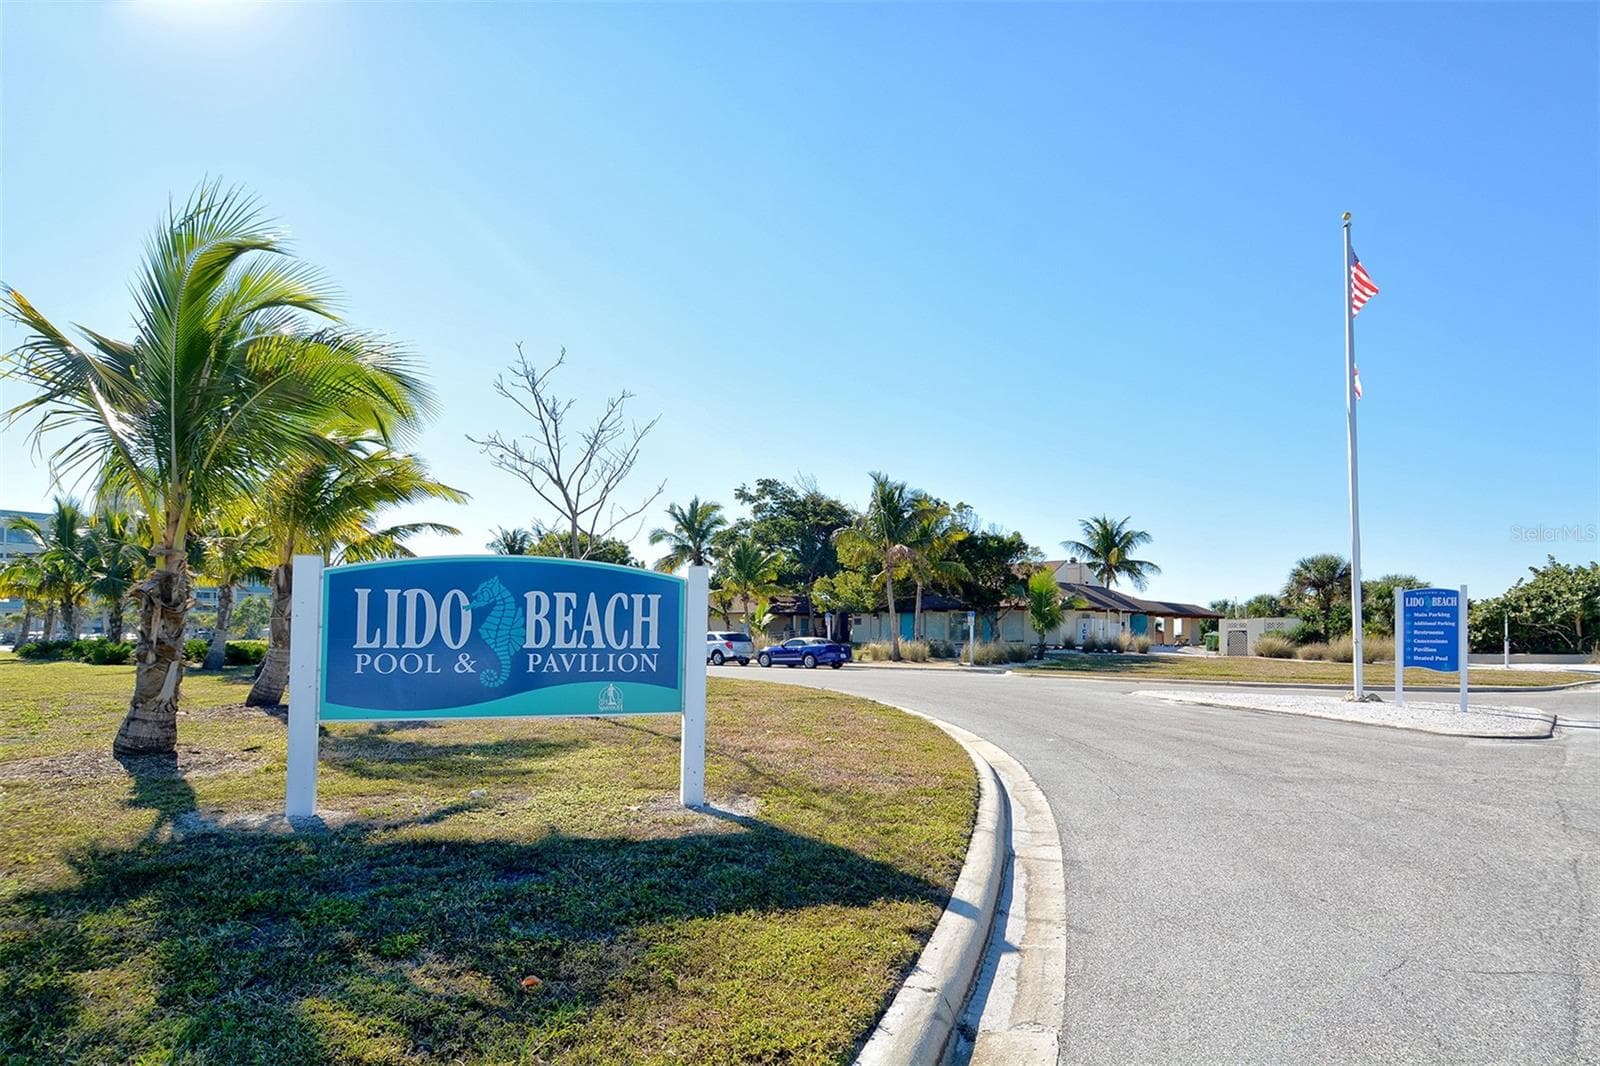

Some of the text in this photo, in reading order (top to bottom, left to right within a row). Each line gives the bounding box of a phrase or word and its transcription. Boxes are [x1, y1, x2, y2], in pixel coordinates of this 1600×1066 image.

[1406, 597, 1456, 606] LIDO BEACH
[353, 588, 662, 650] LIDO BEACH
[354, 652, 658, 675] POOL & PAVILION
